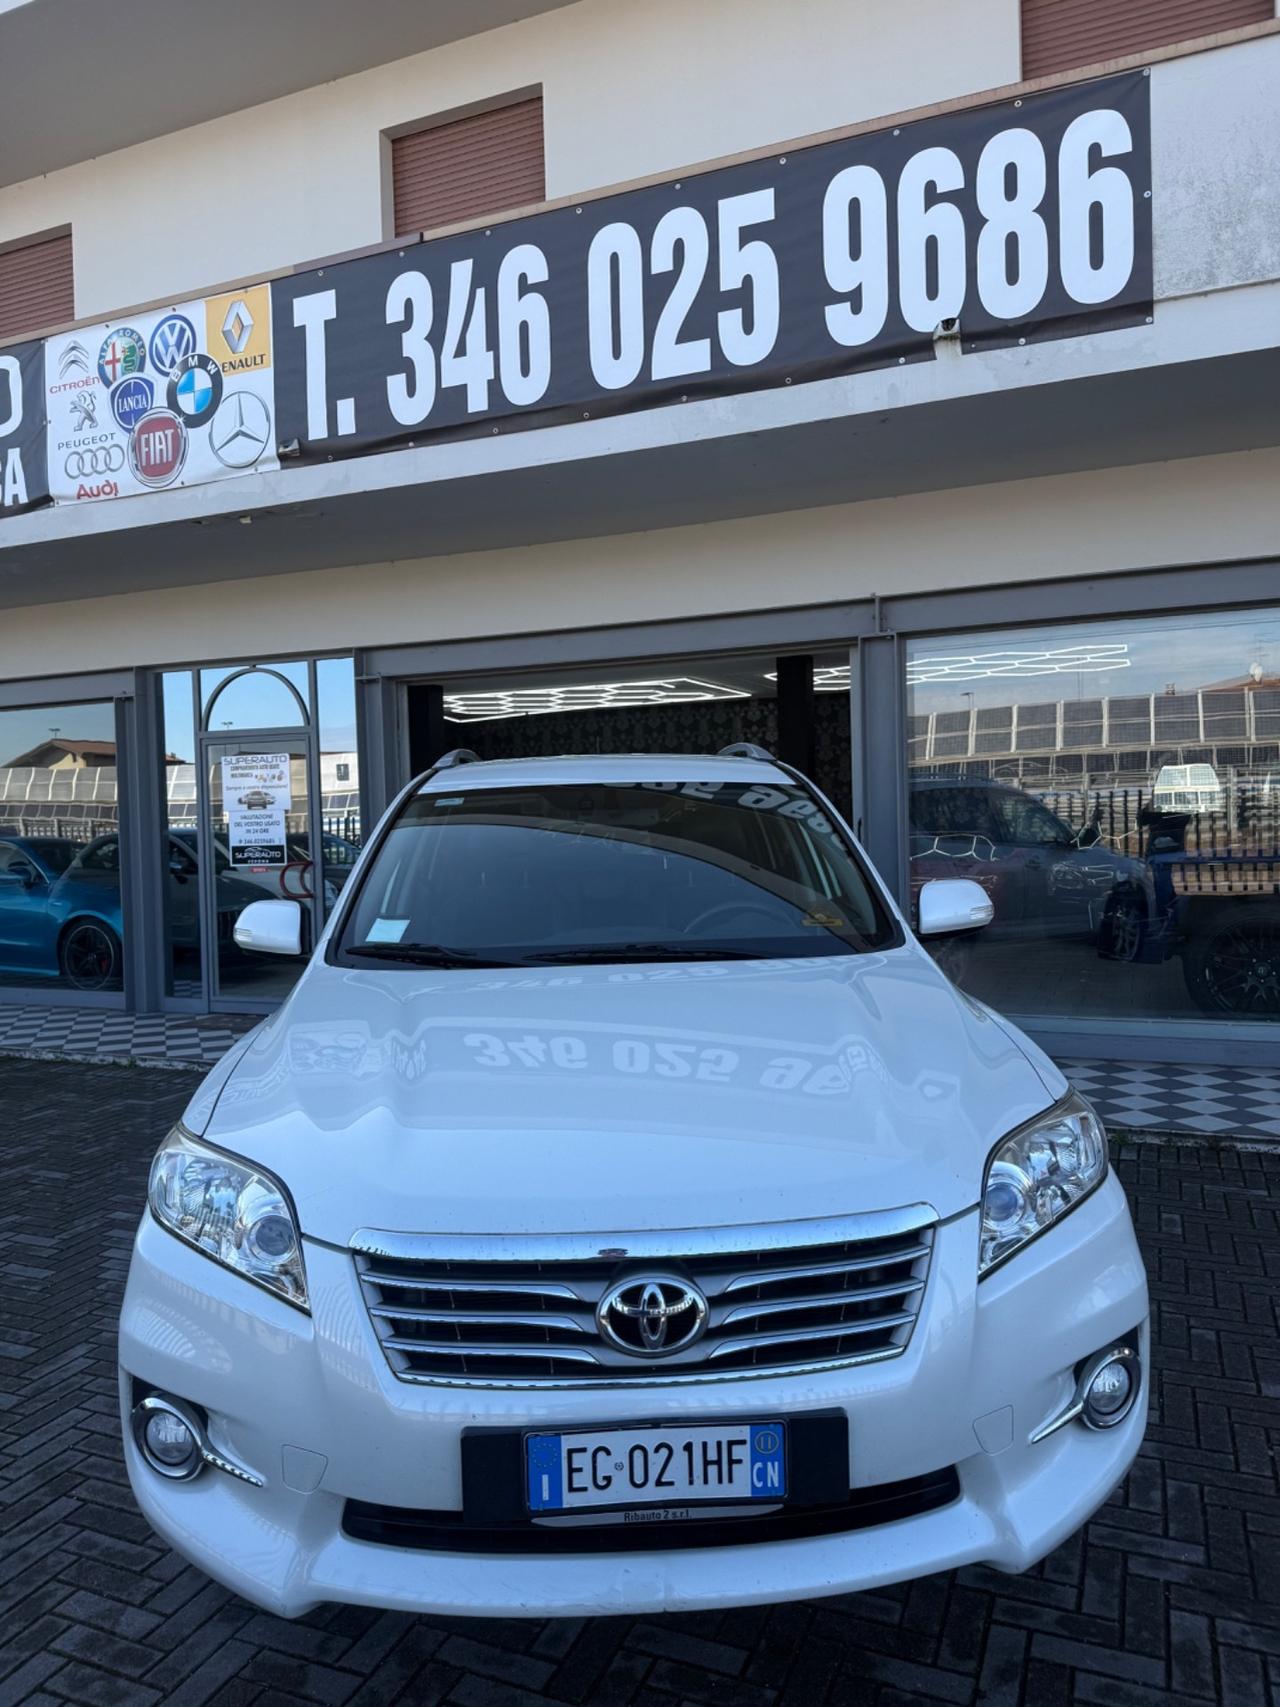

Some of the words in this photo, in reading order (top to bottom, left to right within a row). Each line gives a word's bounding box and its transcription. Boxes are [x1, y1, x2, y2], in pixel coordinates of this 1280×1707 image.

[292, 288, 356, 441] T.
[385, 243, 551, 426] 346
[587, 187, 780, 390] 025
[822, 109, 1135, 346] 9686
[118, 395, 148, 412] LANCIA
[57, 432, 117, 450] PEUGEOT
[141, 428, 175, 467] FIAT
[0, 447, 29, 506] A
[76, 480, 119, 500] Audi
[223, 755, 288, 765] SUPERAUTO
[235, 851, 281, 859] SUPERAUTO
[753, 1461, 779, 1488] CN
[624, 1511, 661, 1522] Ribauto
[664, 1510, 670, 1519] 2
